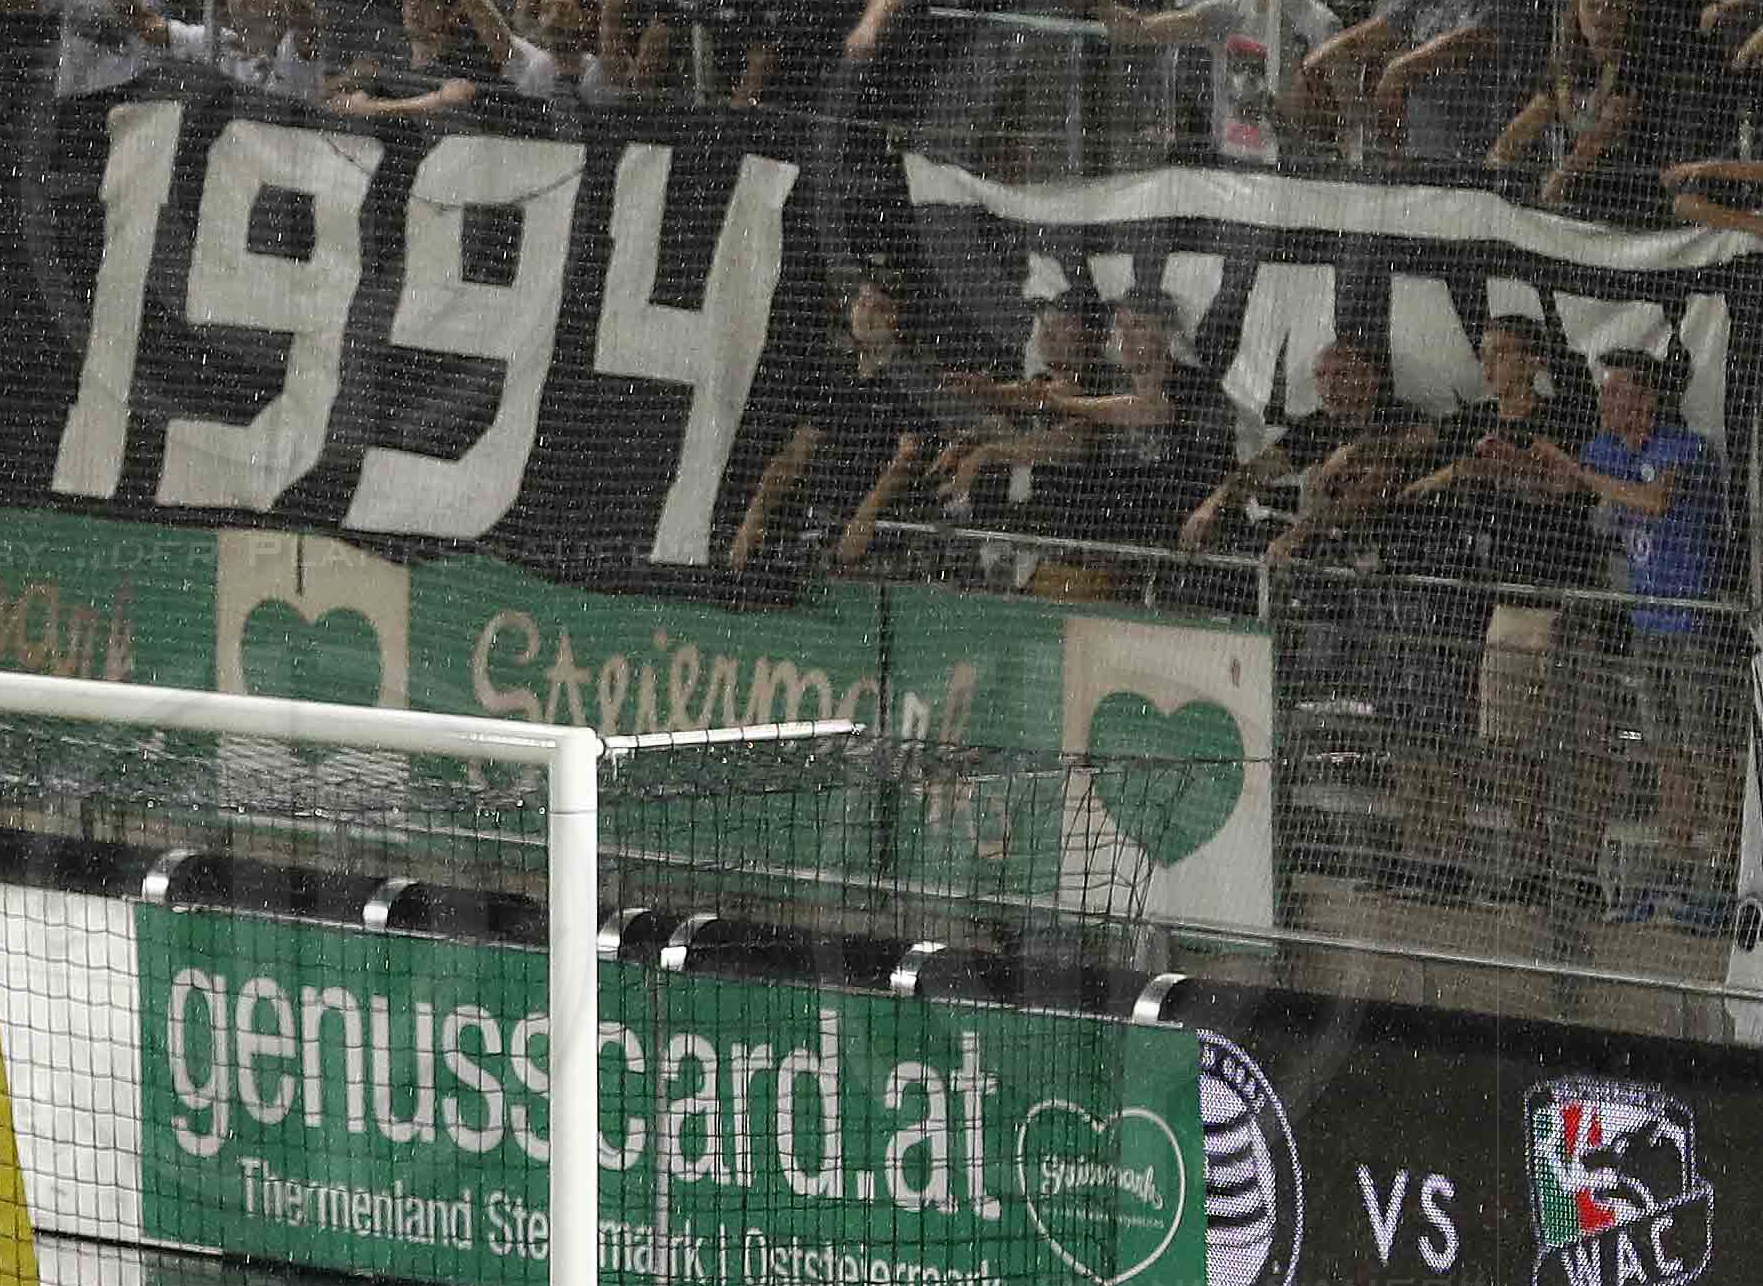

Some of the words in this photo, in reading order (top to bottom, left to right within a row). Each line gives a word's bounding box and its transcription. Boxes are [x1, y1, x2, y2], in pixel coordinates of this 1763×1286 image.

[52, 99, 798, 564] 1994
[166, 965, 1003, 1219] genusscard.at
[238, 1156, 472, 1252] Thermenland
[488, 1193, 707, 1285] Stemark
[1355, 1162, 1460, 1273] VS
